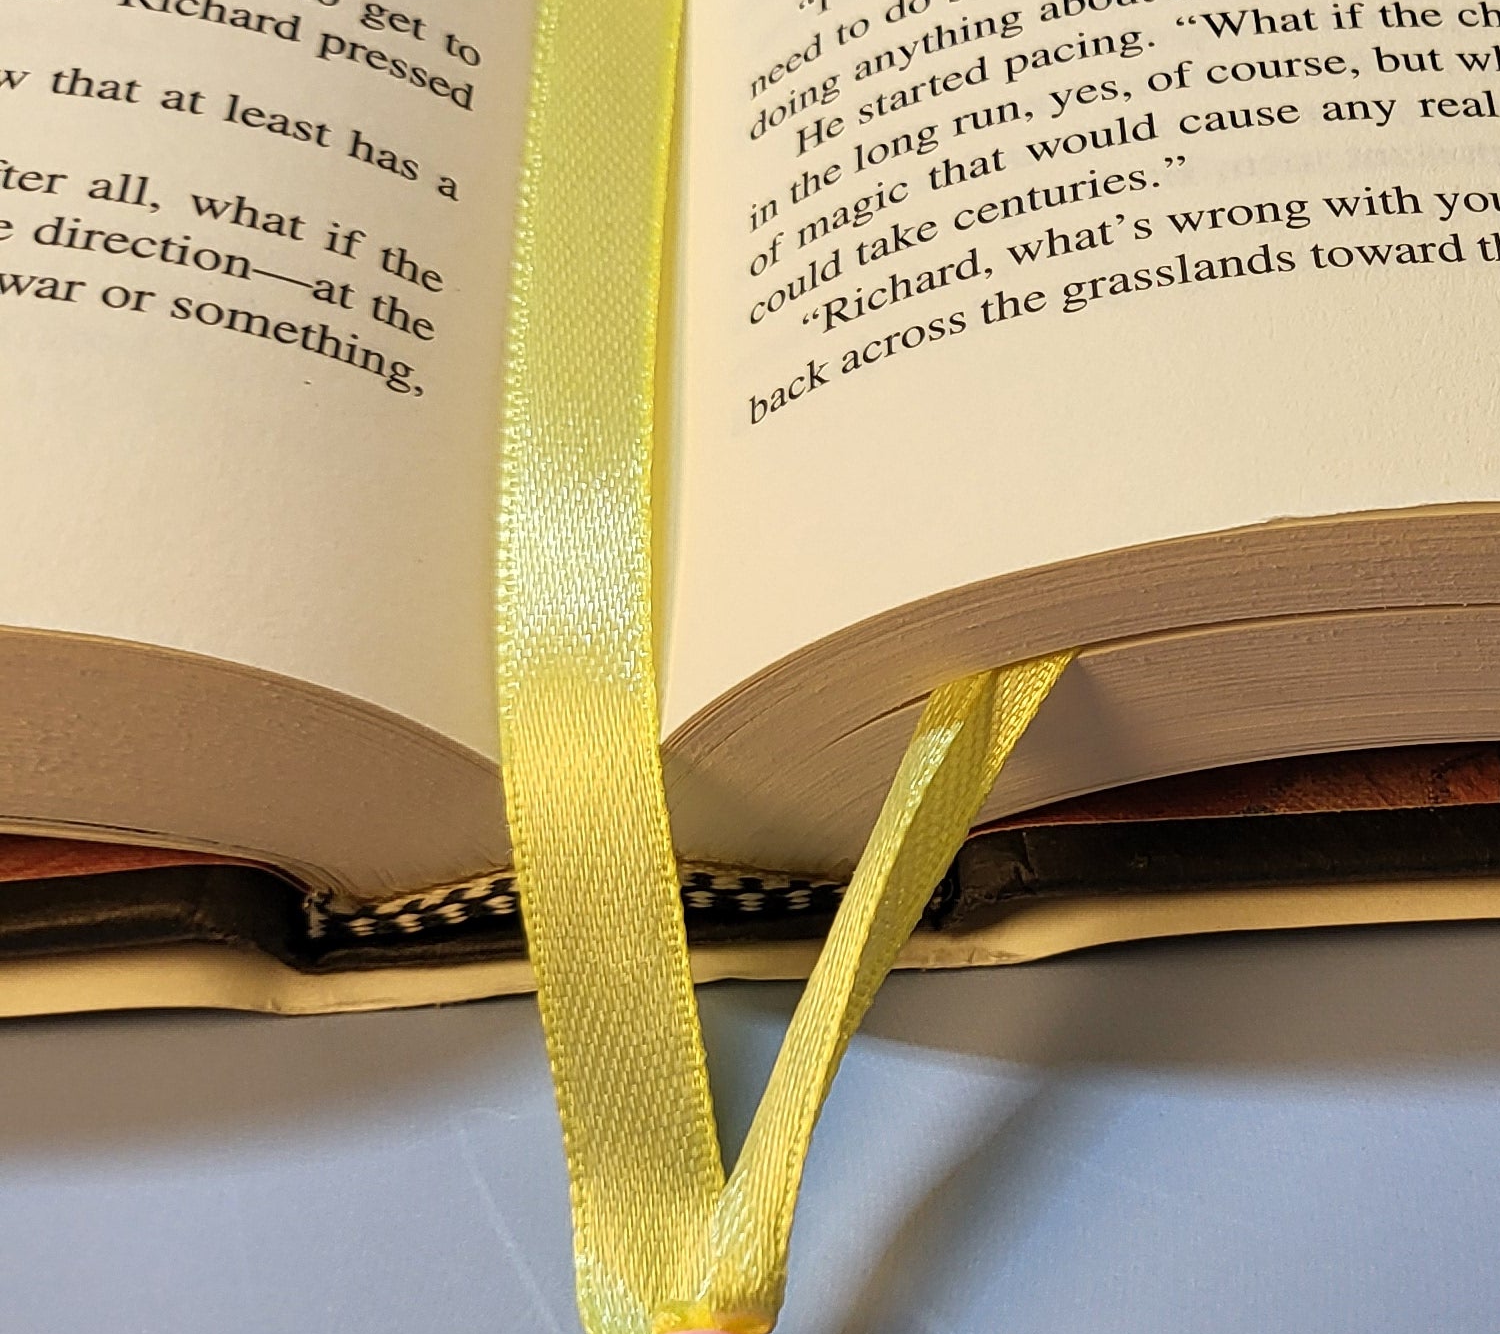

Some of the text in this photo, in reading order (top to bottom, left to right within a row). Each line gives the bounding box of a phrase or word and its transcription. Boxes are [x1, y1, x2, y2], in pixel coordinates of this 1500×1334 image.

[315, 32, 474, 112] pressed
[749, 74, 841, 141] doing
[854, 10, 1024, 82] anything
[751, 32, 822, 99] need
[836, 18, 870, 46] to
[796, 117, 845, 158] He
[858, 55, 990, 126] started
[1003, 31, 1156, 85] pacing.
[1175, 8, 1319, 39] “What
[1331, 2, 1365, 31] if
[1377, 1, 1443, 28] the
[51, 67, 459, 202] that at least has a
[749, 231, 785, 277] of
[797, 181, 909, 250] magic
[928, 148, 1007, 191] that
[1025, 111, 1160, 162] would
[1179, 104, 1301, 135] cause
[1322, 99, 1397, 128] any
[1417, 89, 1500, 118] real
[87, 173, 444, 293] all, what if the
[750, 155, 1186, 325] could take centuries.”
[802, 247, 993, 334] “Richard,
[1006, 214, 1153, 266] what’s
[1165, 199, 1311, 234] wrong
[1321, 185, 1424, 218] with
[0, 272, 424, 398] war or something,
[371, 294, 435, 341] the
[748, 359, 831, 425] back
[841, 311, 967, 375] across
[980, 290, 1047, 325] the
[1062, 243, 1297, 314] grasslands
[1309, 232, 1467, 269] toward
